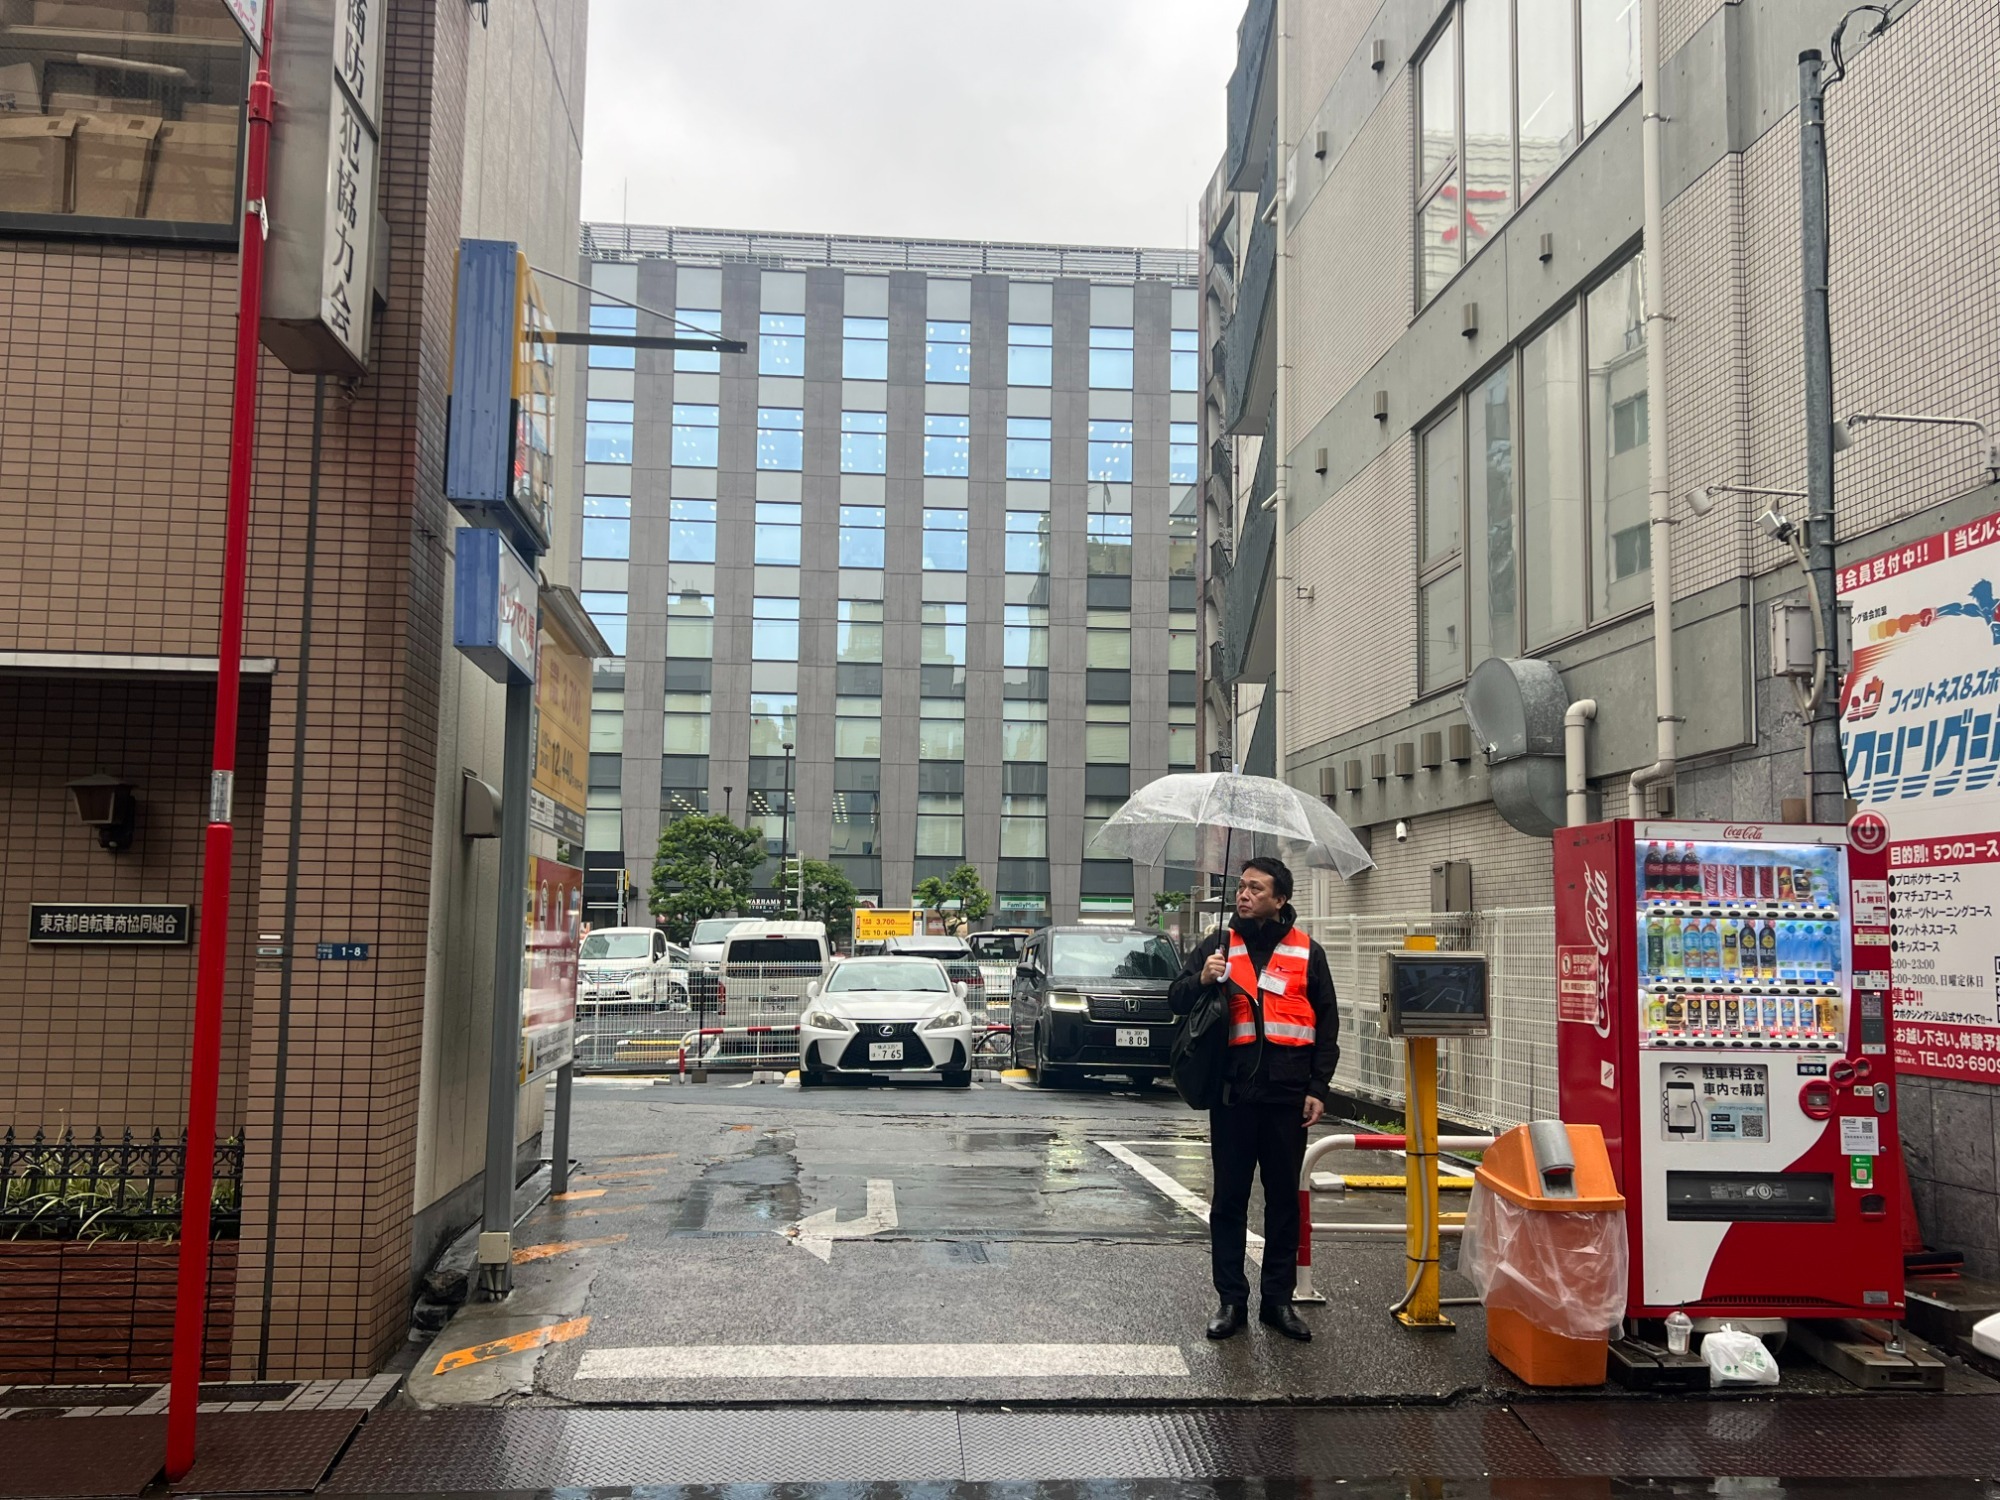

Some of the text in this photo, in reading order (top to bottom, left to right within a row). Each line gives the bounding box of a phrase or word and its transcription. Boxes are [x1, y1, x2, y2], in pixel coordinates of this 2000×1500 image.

[39, 913, 178, 935] 東京都自転車商協同組合
[1702, 1066, 1764, 1081] 駐車料金を
[1703, 1082, 1765, 1097] 車内で精算
